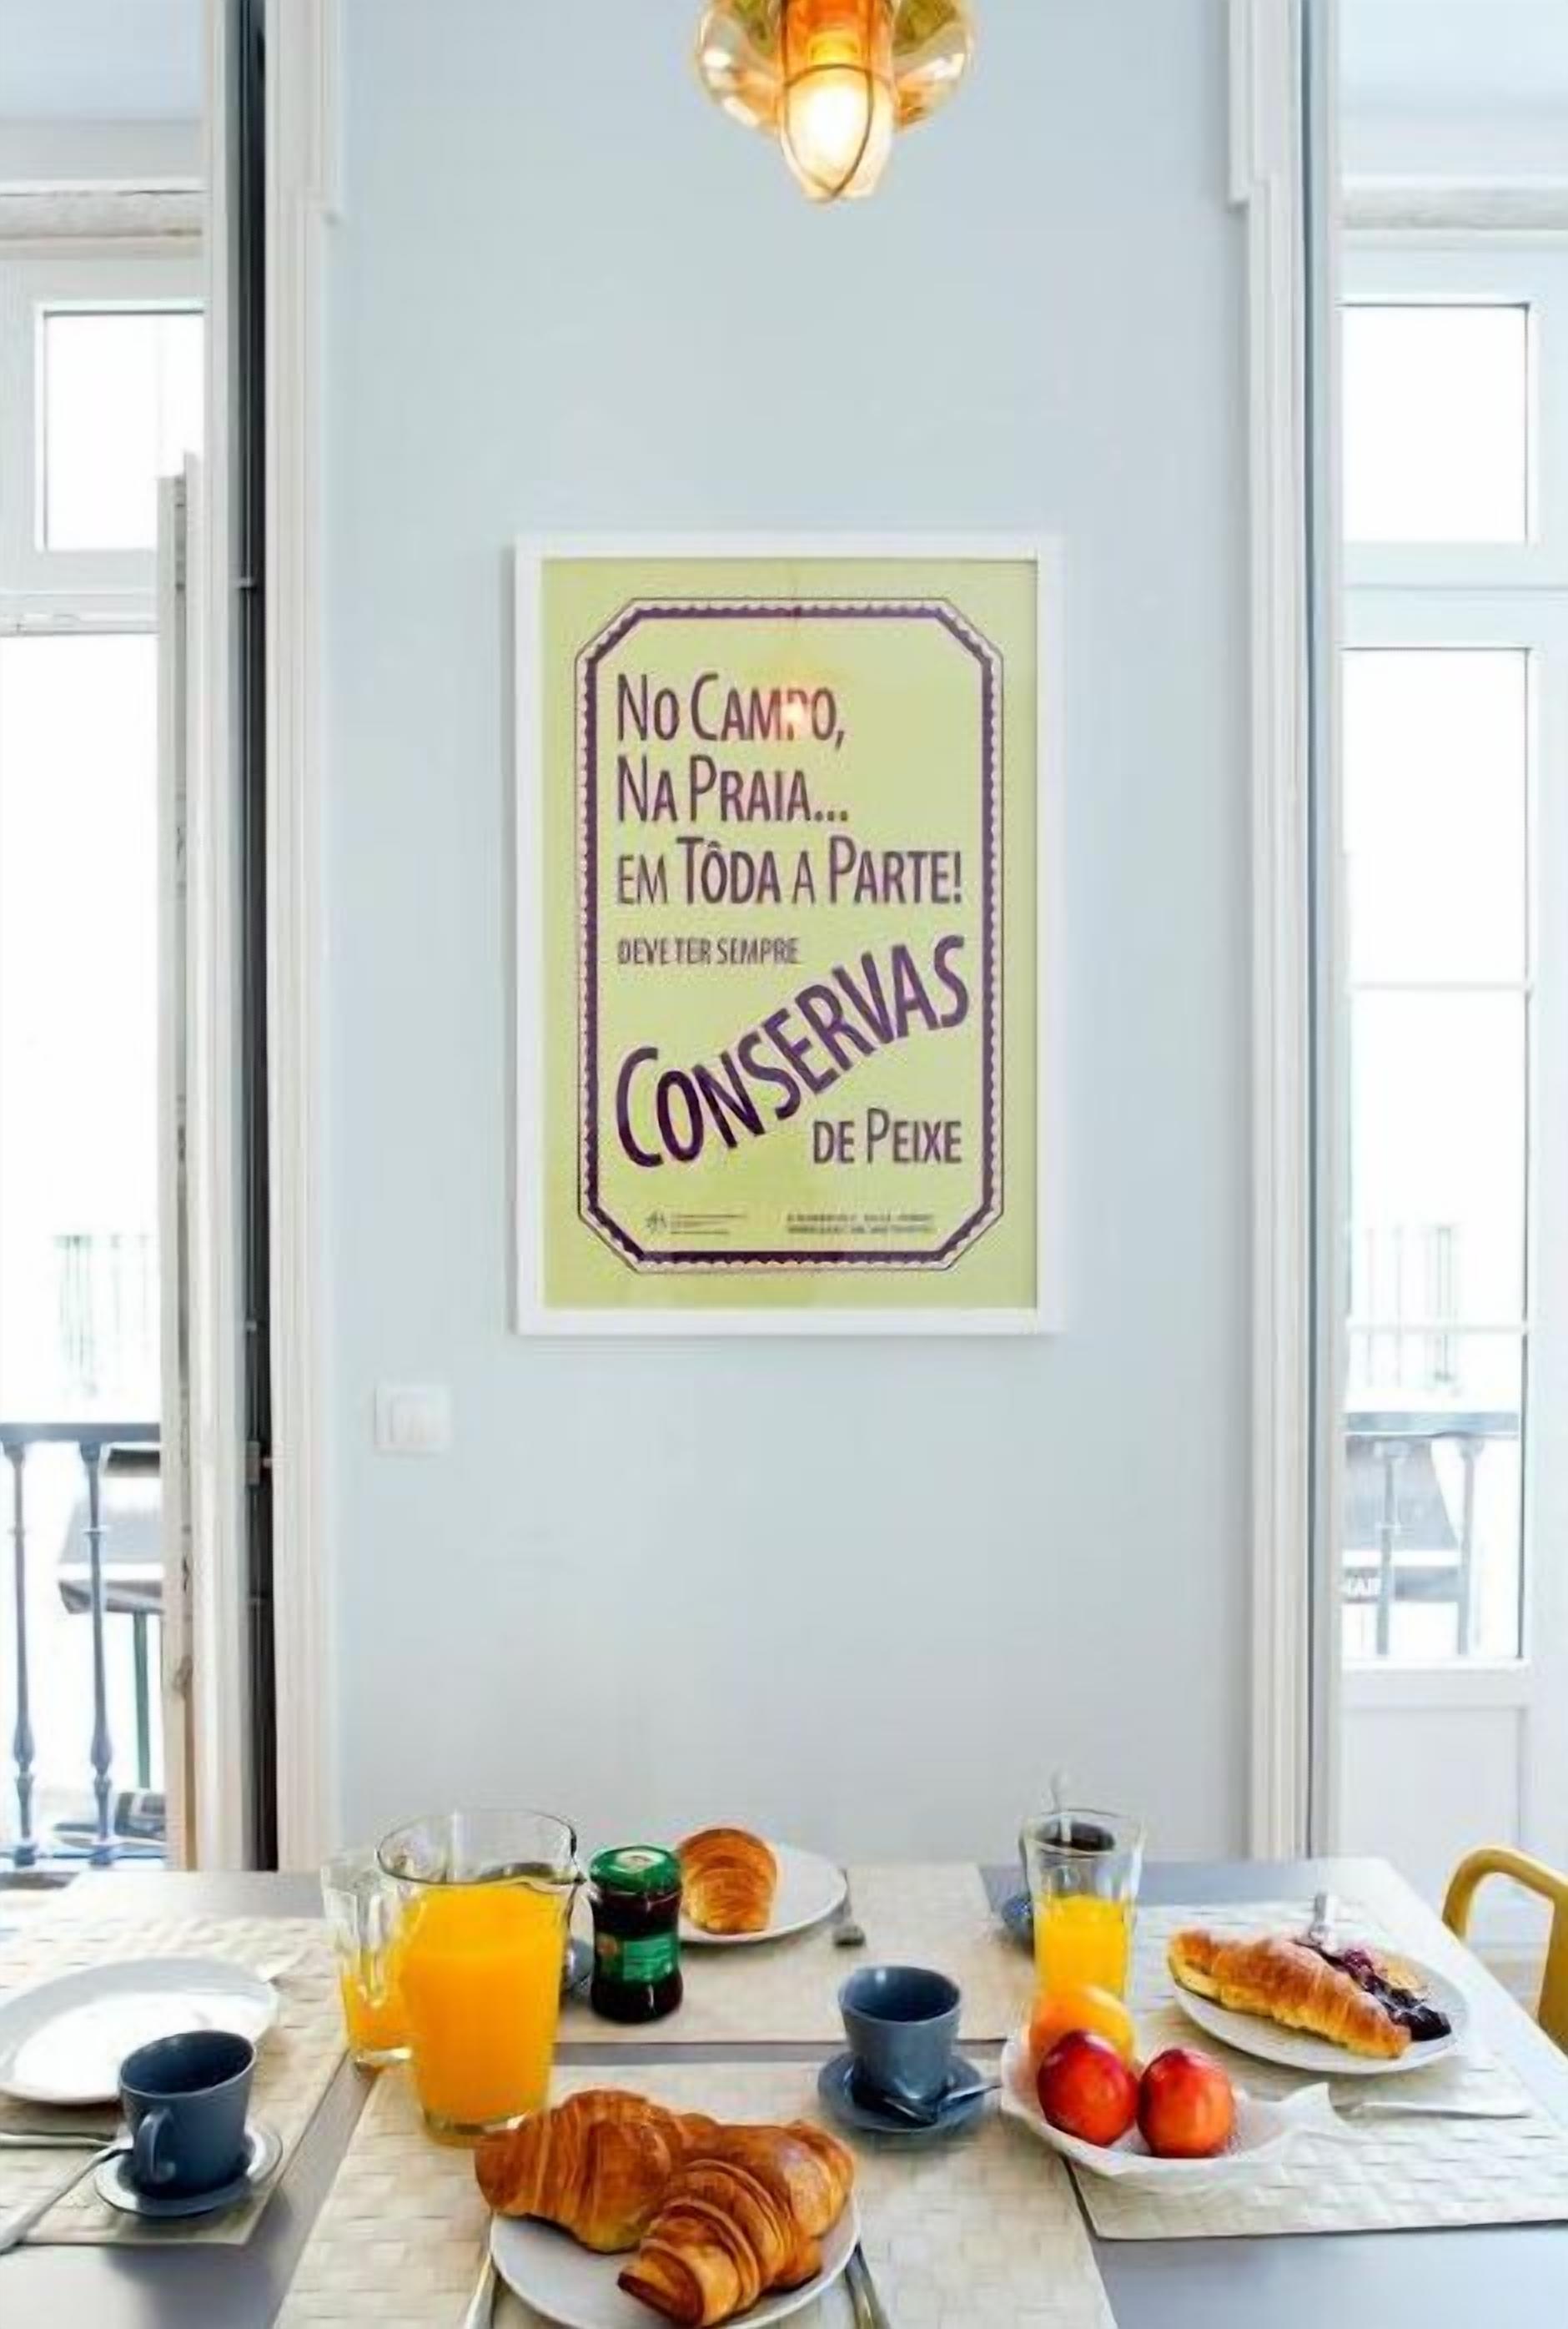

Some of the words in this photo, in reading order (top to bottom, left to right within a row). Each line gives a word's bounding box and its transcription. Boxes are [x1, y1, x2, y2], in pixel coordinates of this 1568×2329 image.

[617, 673, 681, 742] NO
[617, 754, 679, 823] NA
[689, 753, 848, 823] PRAIA...
[618, 853, 668, 905] EM
[676, 836, 781, 905] TÔDA
[792, 850, 816, 904] A
[829, 835, 962, 905] PARTE!
[617, 938, 671, 966] DEVE
[675, 938, 711, 966] TER
[716, 938, 800, 966] SEMPRE
[615, 933, 970, 1168] CONSERVAS
[812, 1119, 855, 1164] DE
[867, 1107, 962, 1164] PEIXE
